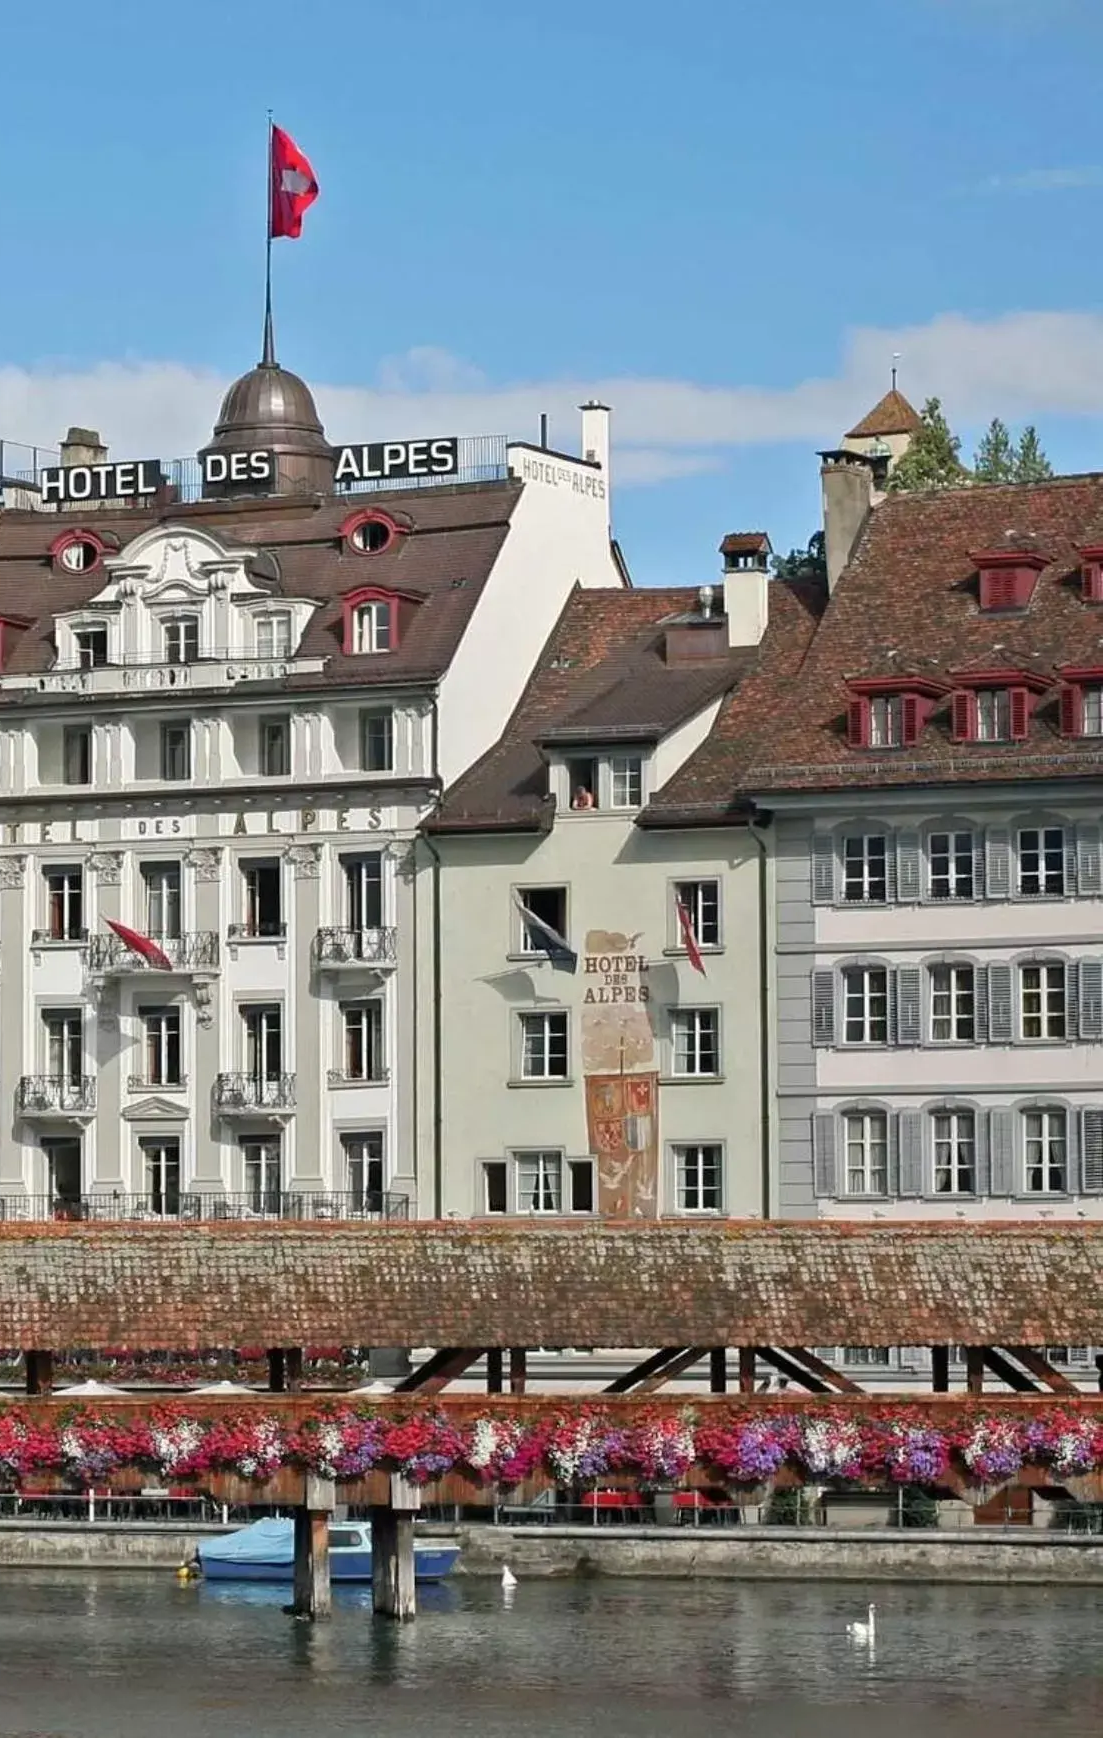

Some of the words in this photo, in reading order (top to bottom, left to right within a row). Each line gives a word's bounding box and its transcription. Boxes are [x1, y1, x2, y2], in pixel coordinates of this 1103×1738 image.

[42, 463, 157, 501] HOTEL
[205, 451, 271, 482] DES
[335, 441, 454, 479] ALPES
[523, 457, 559, 487] HOTEL
[572, 471, 606, 500] ALPES
[138, 820, 182, 835] DES
[233, 807, 383, 835] ALPES
[584, 955, 650, 973] HOTEL
[604, 973, 628, 986] DES
[584, 985, 650, 1004] ALPES
